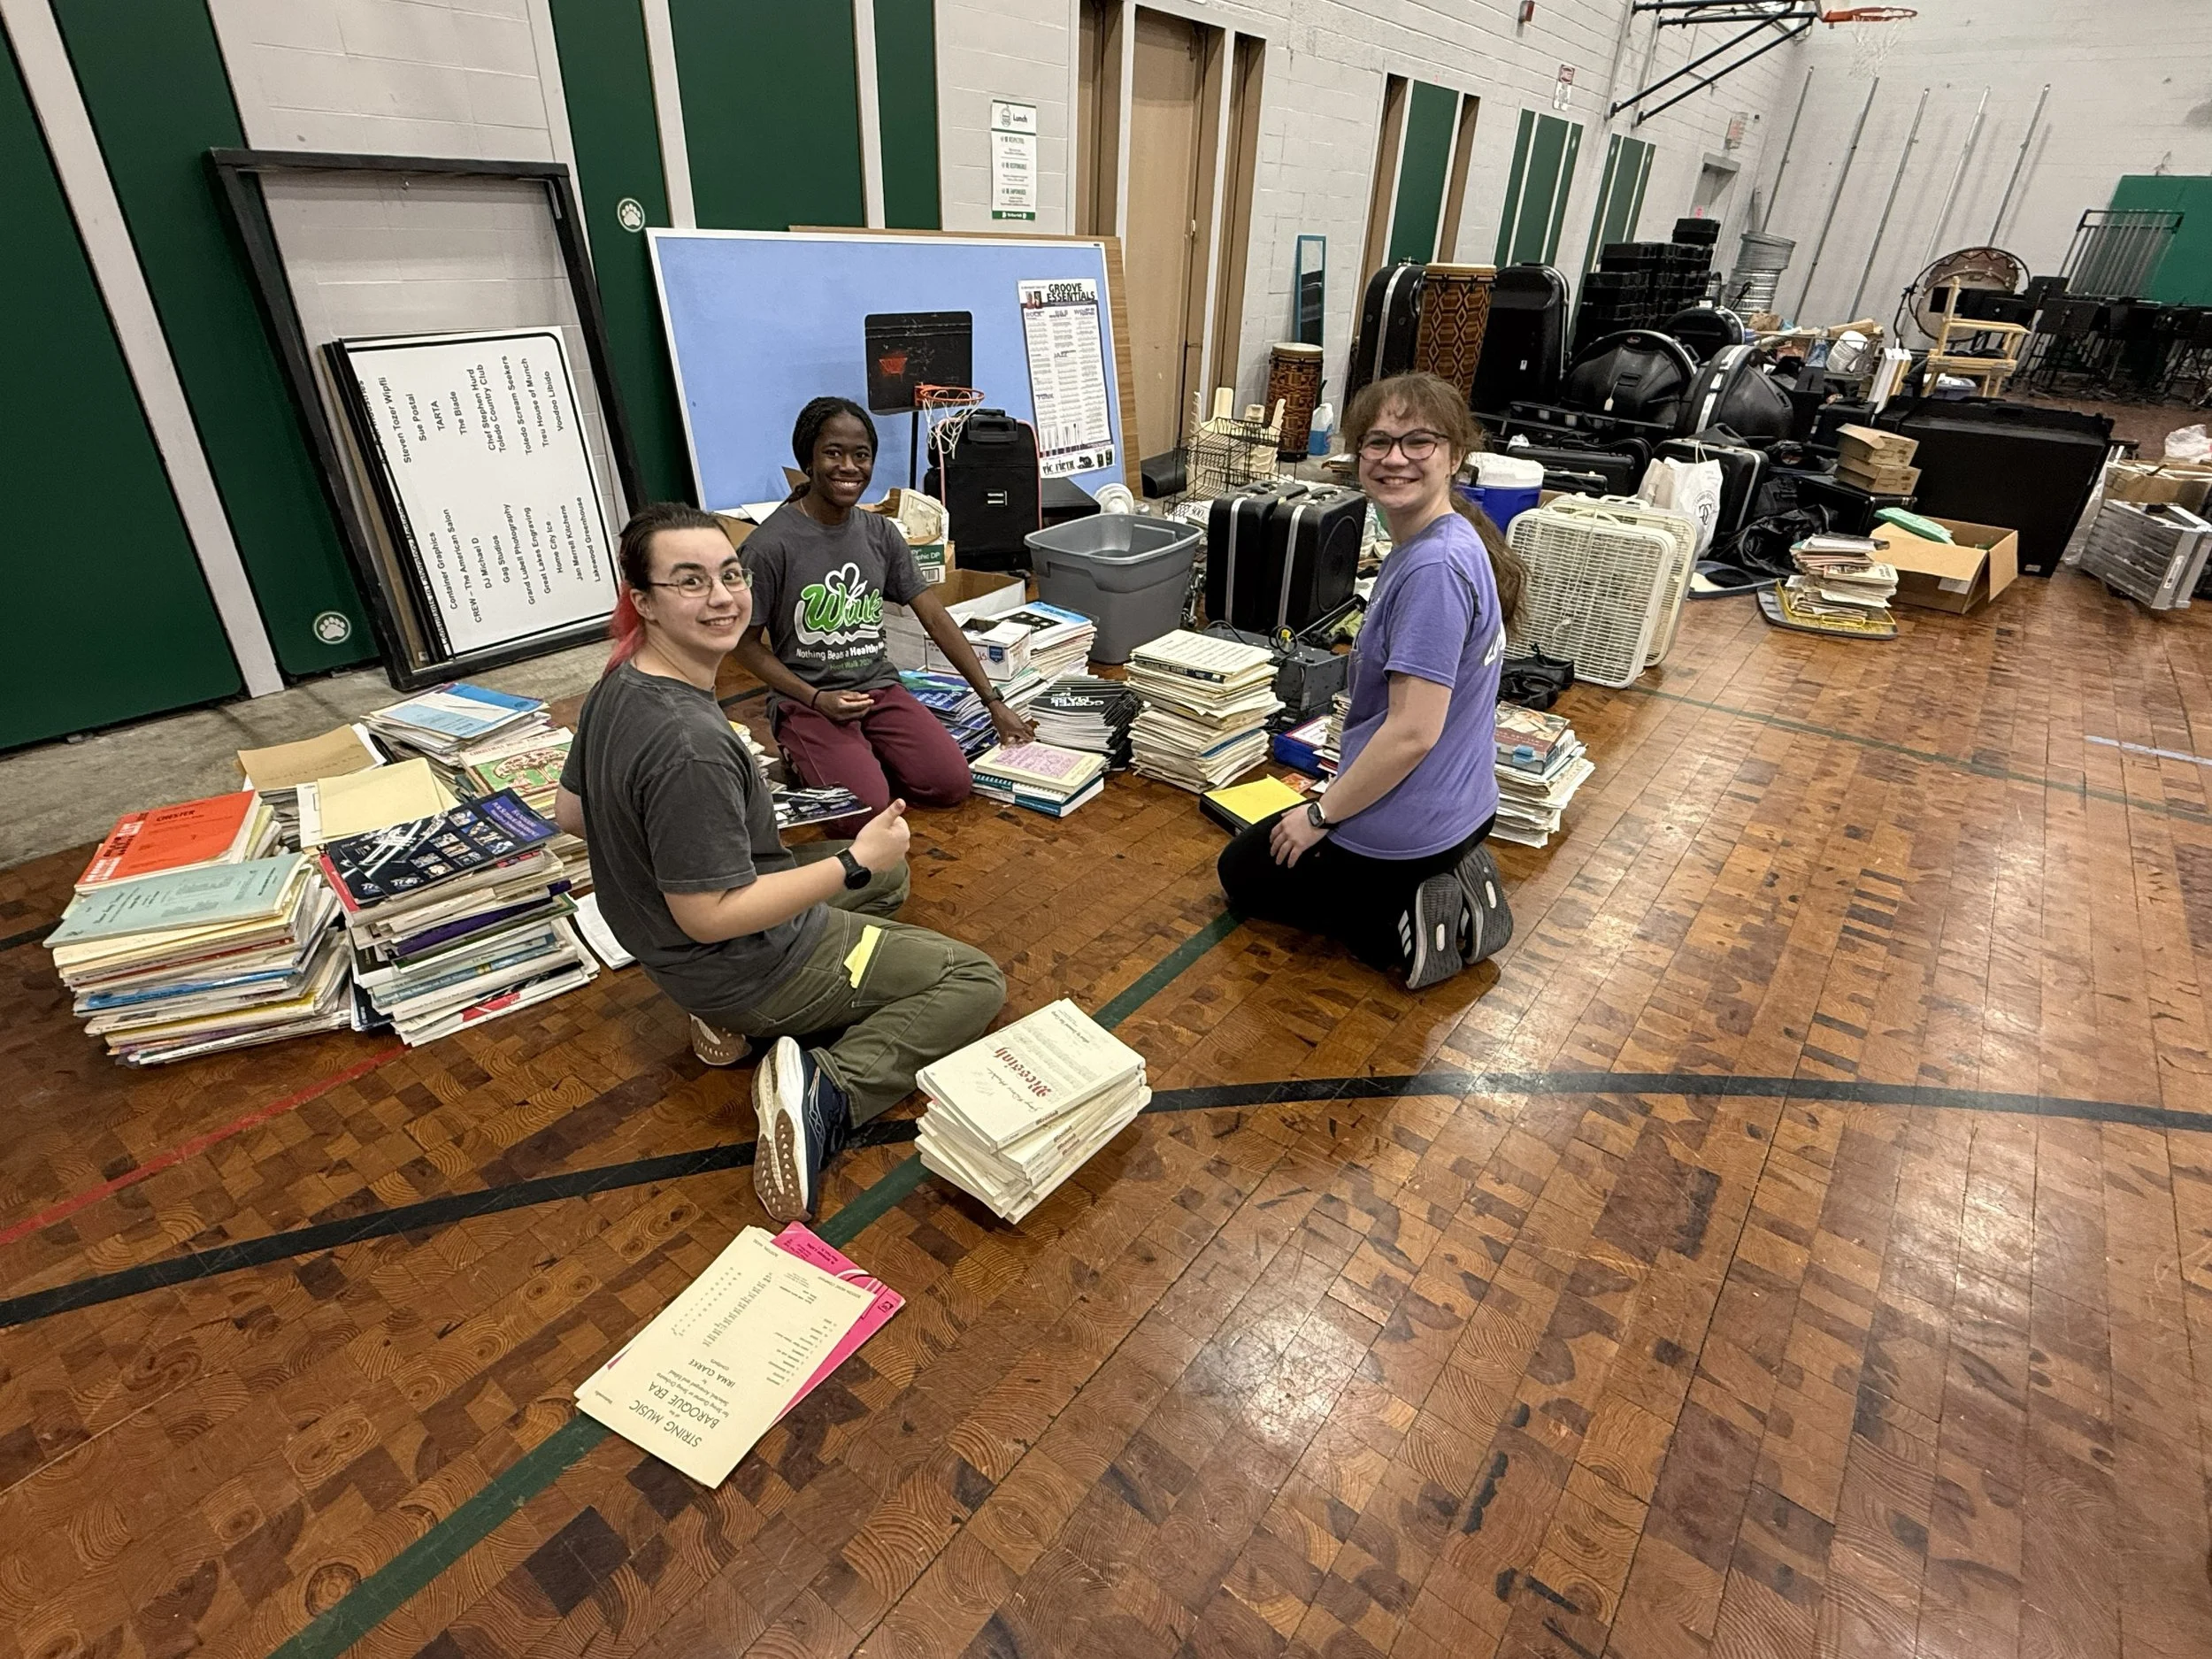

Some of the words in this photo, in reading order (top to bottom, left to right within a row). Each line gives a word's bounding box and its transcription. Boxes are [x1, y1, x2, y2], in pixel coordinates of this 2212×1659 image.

[1013, 113, 1027, 123] Lunch
[1047, 291, 1095, 303] ESSENTIALS
[1048, 283, 1082, 293] GROOVE
[465, 368, 479, 390] Hurd
[476, 364, 488, 385] Club
[501, 355, 515, 390] Seekers
[520, 357, 534, 387] Munch
[543, 371, 555, 397] Libido
[378, 377, 392, 403] Wipfli
[405, 393, 420, 421] Postal
[430, 400, 445, 431] TARTA
[449, 391, 462, 416] Blade
[474, 392, 489, 428] Stephen
[483, 387, 497, 422] Country
[511, 392, 524, 425] Scream
[532, 399, 543, 426] House
[551, 399, 564, 431] Voodoo
[388, 405, 401, 431] Tozer
[457, 418, 467, 435] The
[417, 424, 426, 441] Sue
[483, 430, 495, 450] Chef
[494, 423, 506, 452] Toledo
[520, 426, 532, 455] Toledo
[540, 428, 549, 447] Treu
[396, 432, 411, 463] Steven
[442, 509, 455, 533] Salon
[503, 503, 521, 555] Photography
[523, 507, 539, 547] Engraving
[560, 504, 572, 539] Kitchens
[576, 496, 591, 543] Greenhouse
[429, 532, 445, 569] Graphics
[450, 534, 467, 572] American
[492, 534, 505, 565] Studios
[549, 534, 557, 549] City
[567, 540, 579, 566] Merrell
[473, 545, 488, 576] Michael
[516, 556, 528, 580] Lubell
[534, 549, 545, 572] Lakes
[553, 550, 563, 573] Home
[586, 544, 601, 582] Lakewood
[463, 574, 472, 590] The
[482, 577, 492, 588] DJ
[501, 566, 510, 583] Gag
[541, 572, 550, 594] Great
[441, 571, 457, 610] Container
[523, 580, 535, 604] Grand
[468, 598, 481, 623] CREW
[801, 582, 883, 632] Walk
[796, 648, 826, 661] Nothing
[849, 644, 878, 657] Healthy
[155, 809, 196, 822] CHESTER
[993, 1047, 1051, 1097] Messiah
[687, 1358, 715, 1376] CLARKE
[716, 1373, 735, 1387] IRMA
[648, 1381, 669, 1399] ERA
[628, 1399, 664, 1424] MUSIC
[667, 1394, 719, 1429] BAROQUE
[663, 1420, 702, 1447] STRING
